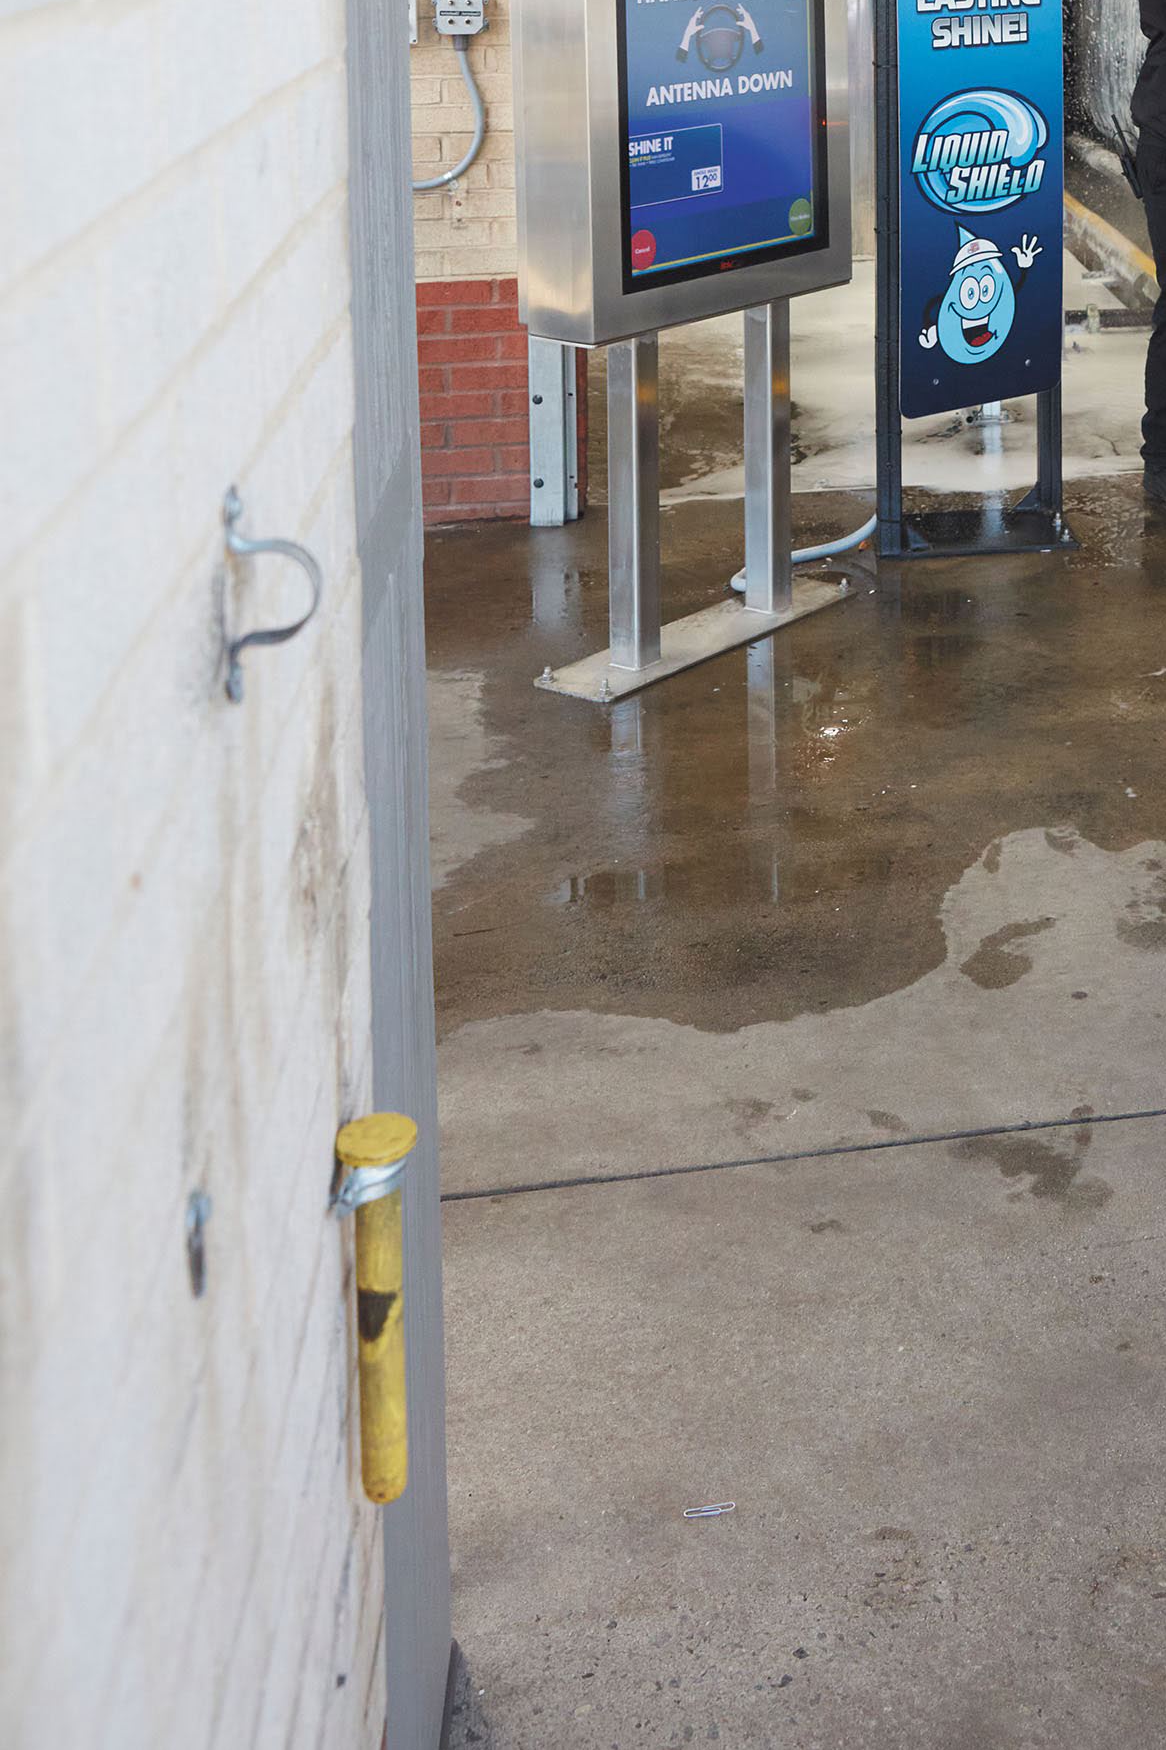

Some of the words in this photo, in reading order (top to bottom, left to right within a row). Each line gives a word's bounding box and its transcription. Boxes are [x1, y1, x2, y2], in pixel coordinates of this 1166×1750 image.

[932, 13, 1027, 48] SHINE!
[646, 78, 733, 107] ANTENNA
[738, 70, 793, 94] DOWN
[629, 138, 661, 157] SHINE
[664, 136, 674, 150] IT
[911, 130, 1009, 175] LIQUID
[945, 159, 1046, 203] SHIELD
